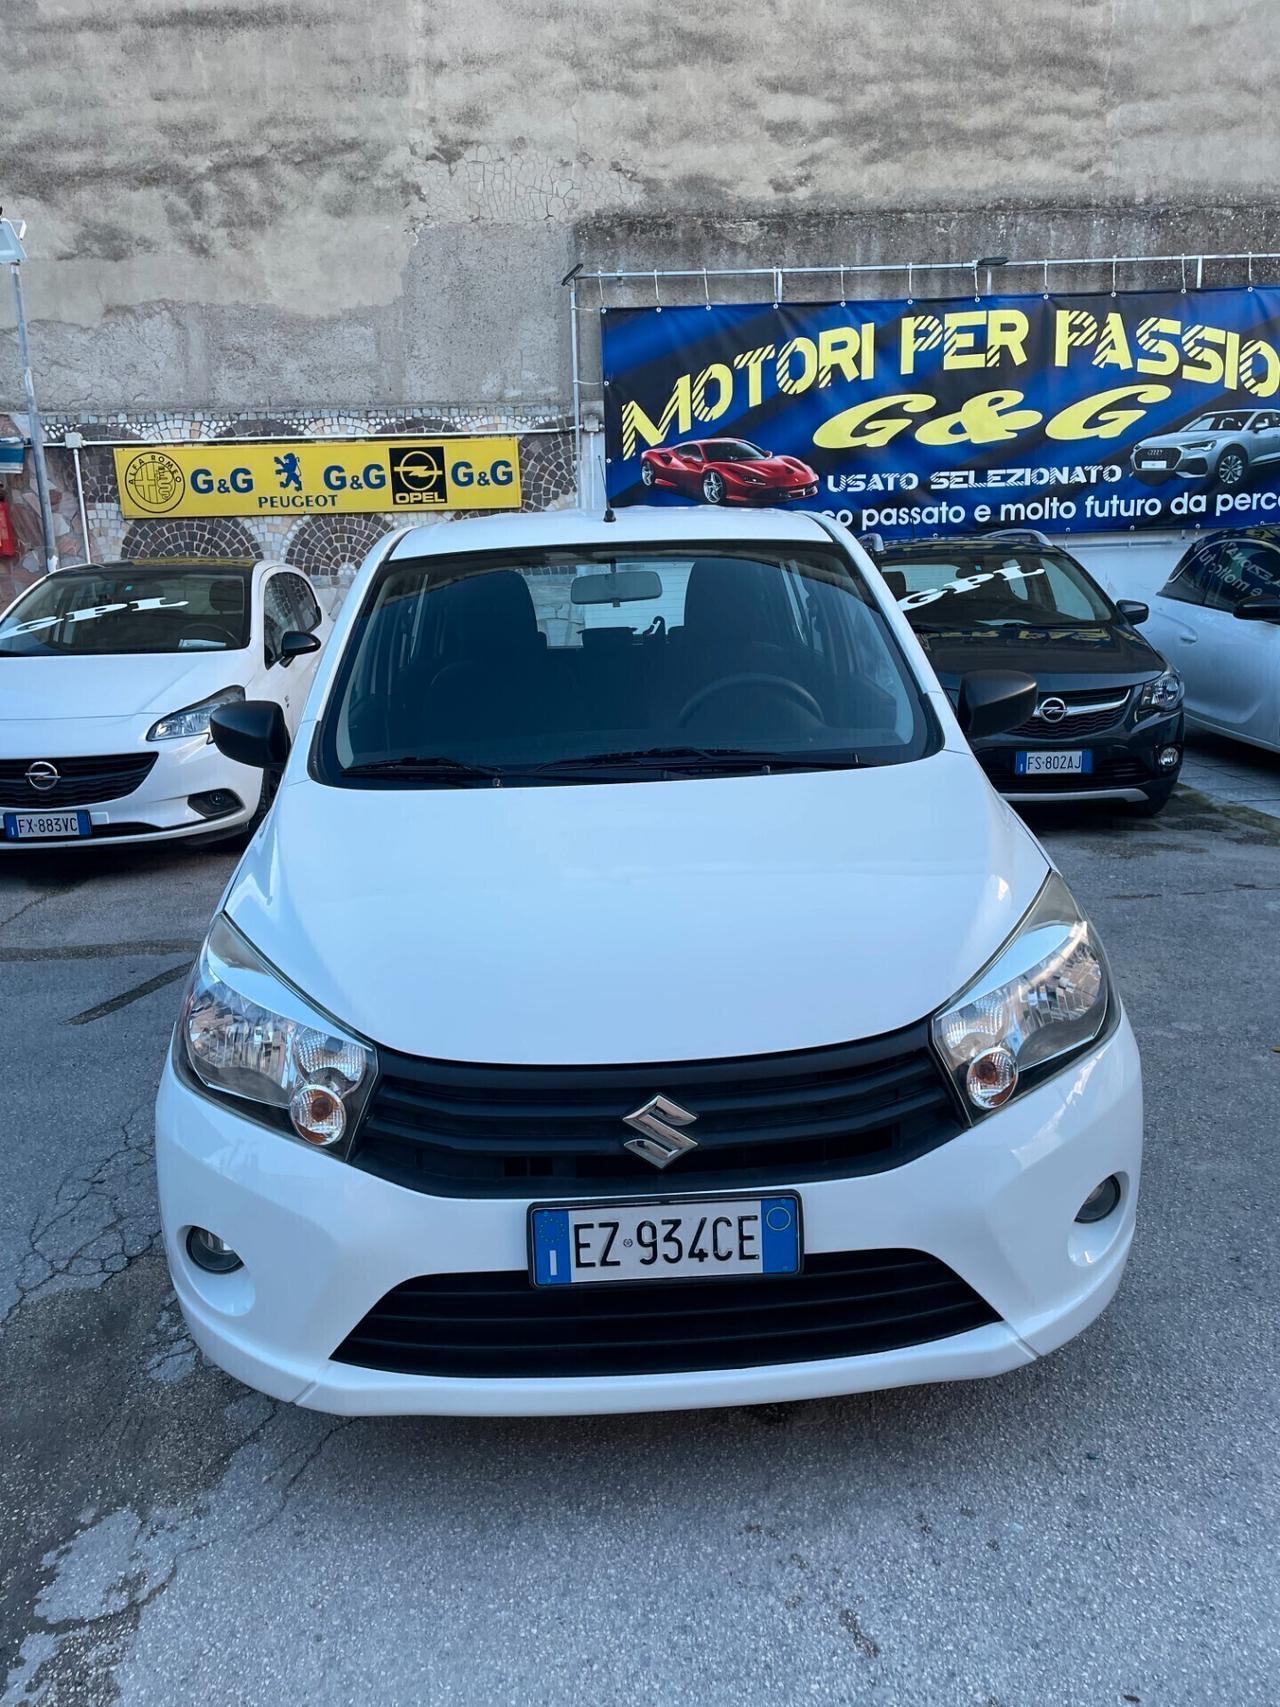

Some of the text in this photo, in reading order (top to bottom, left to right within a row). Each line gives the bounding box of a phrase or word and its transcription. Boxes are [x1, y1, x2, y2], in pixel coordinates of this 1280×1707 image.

[622, 309, 1280, 461] MOTORI PER PASSIO
[812, 384, 1172, 449] G&G
[128, 454, 182, 485] ALFA ROMEO
[190, 467, 254, 494] G&G
[323, 463, 386, 490] G&G
[451, 460, 514, 487] G&G
[827, 464, 1122, 492] USATO SELEZIONATO
[258, 494, 338, 508] PEUGEOT
[395, 492, 445, 504] OPEL
[862, 501, 966, 531] passato
[974, 504, 991, 522] e
[1001, 497, 1077, 521] molto
[1085, 494, 1162, 518] futuro
[1170, 492, 1207, 515] da
[1027, 755, 1081, 770] FS 802AJ
[18, 816, 78, 834] FX 883VC
[574, 1215, 760, 1268] EZ 934CE
